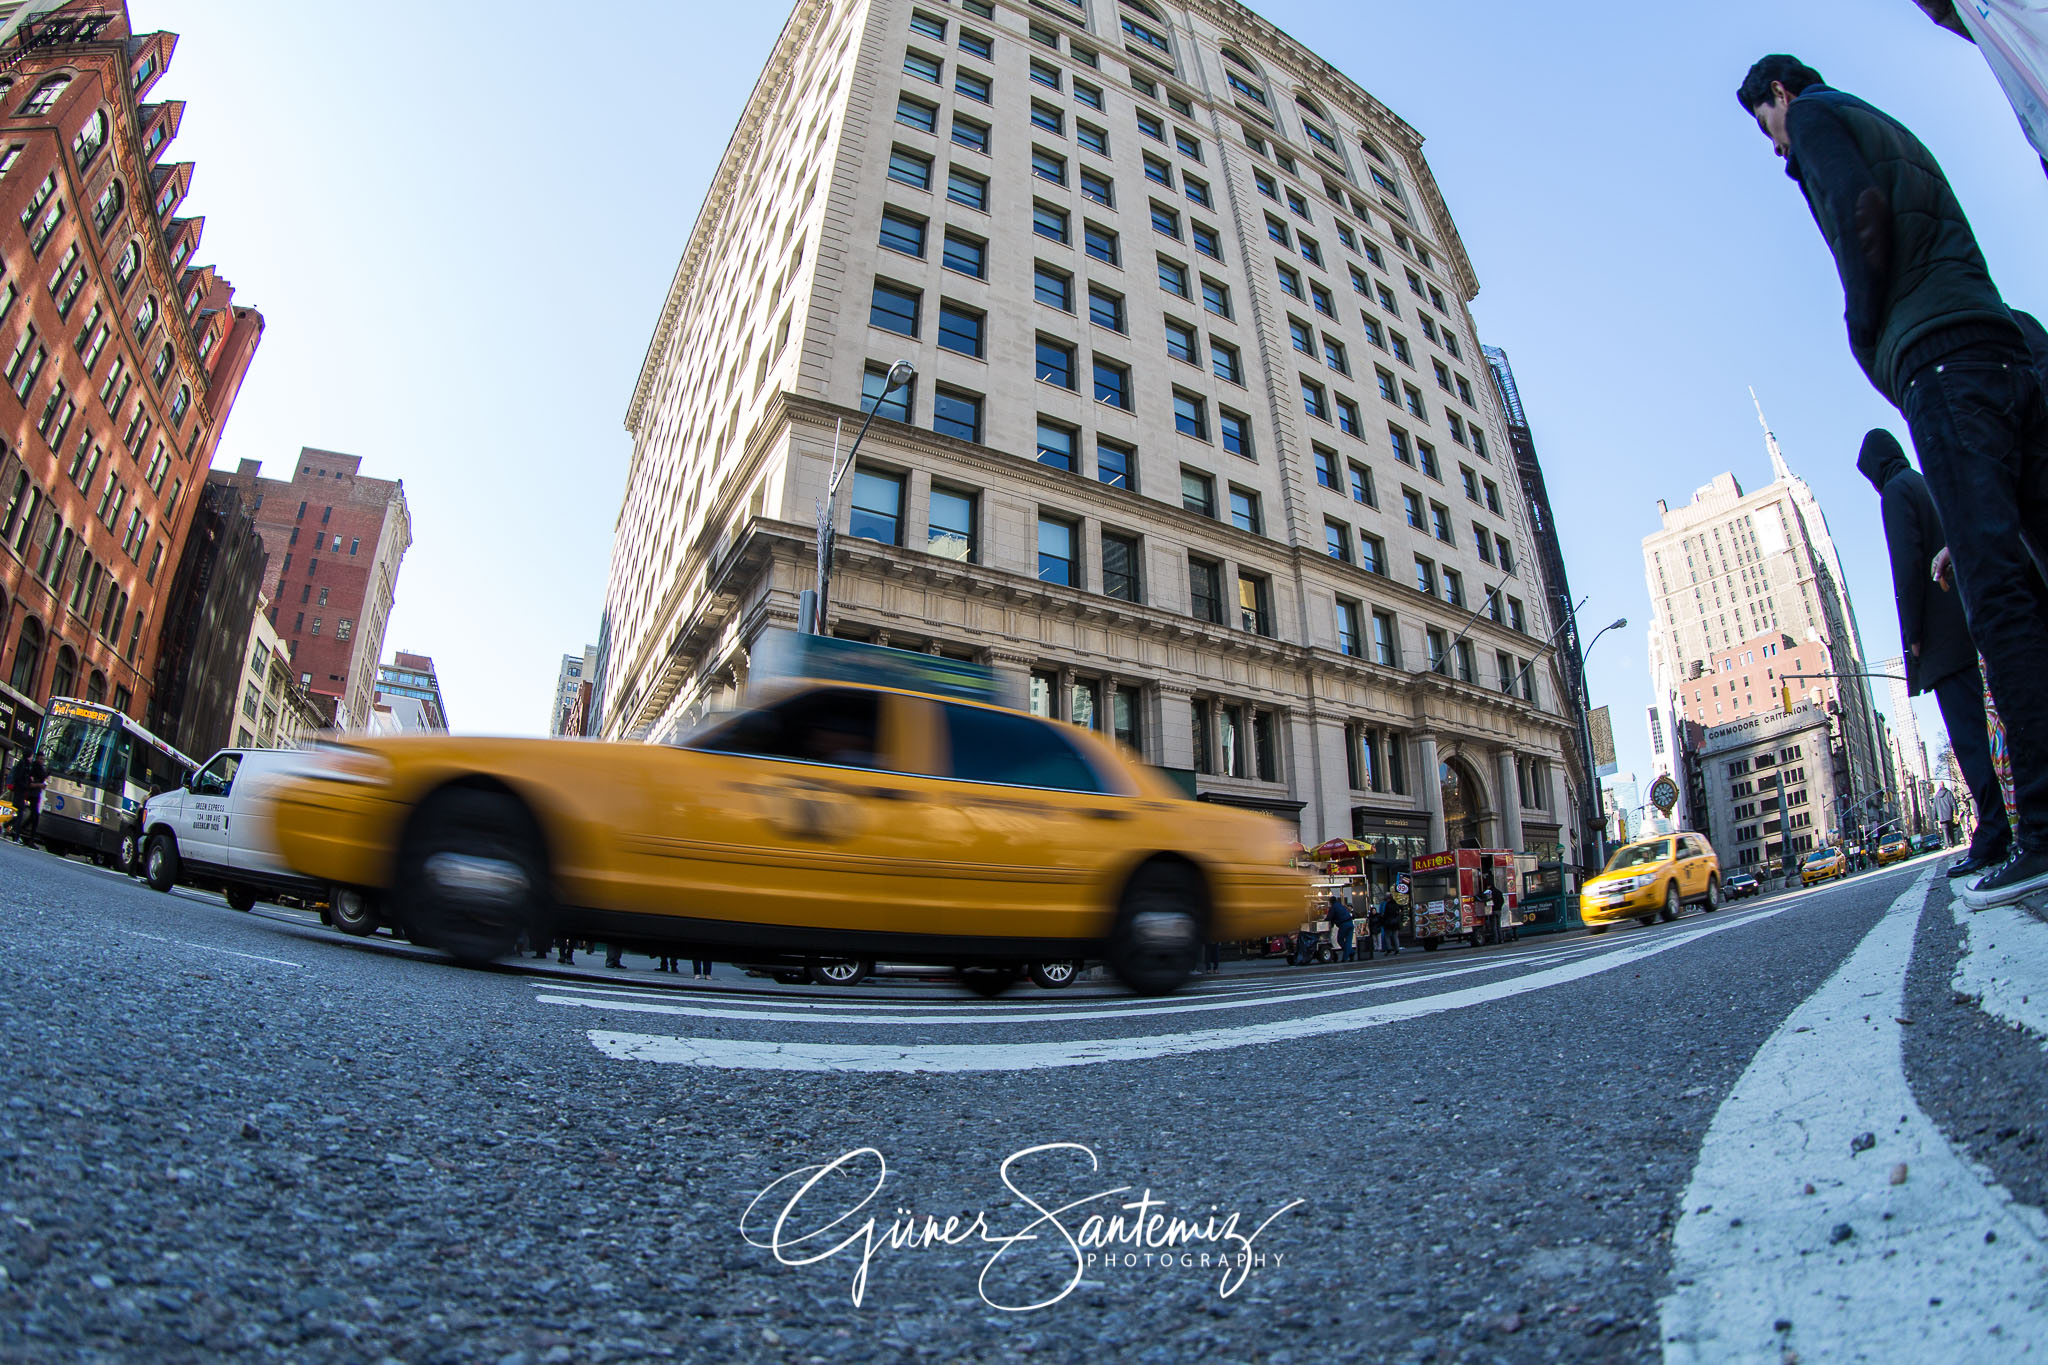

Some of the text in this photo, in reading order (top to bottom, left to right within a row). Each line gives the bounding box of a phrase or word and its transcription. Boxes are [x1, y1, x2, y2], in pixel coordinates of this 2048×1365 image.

[1708, 719, 1760, 740] COMMODORE
[195, 802, 225, 813] GREEN EXPRESS
